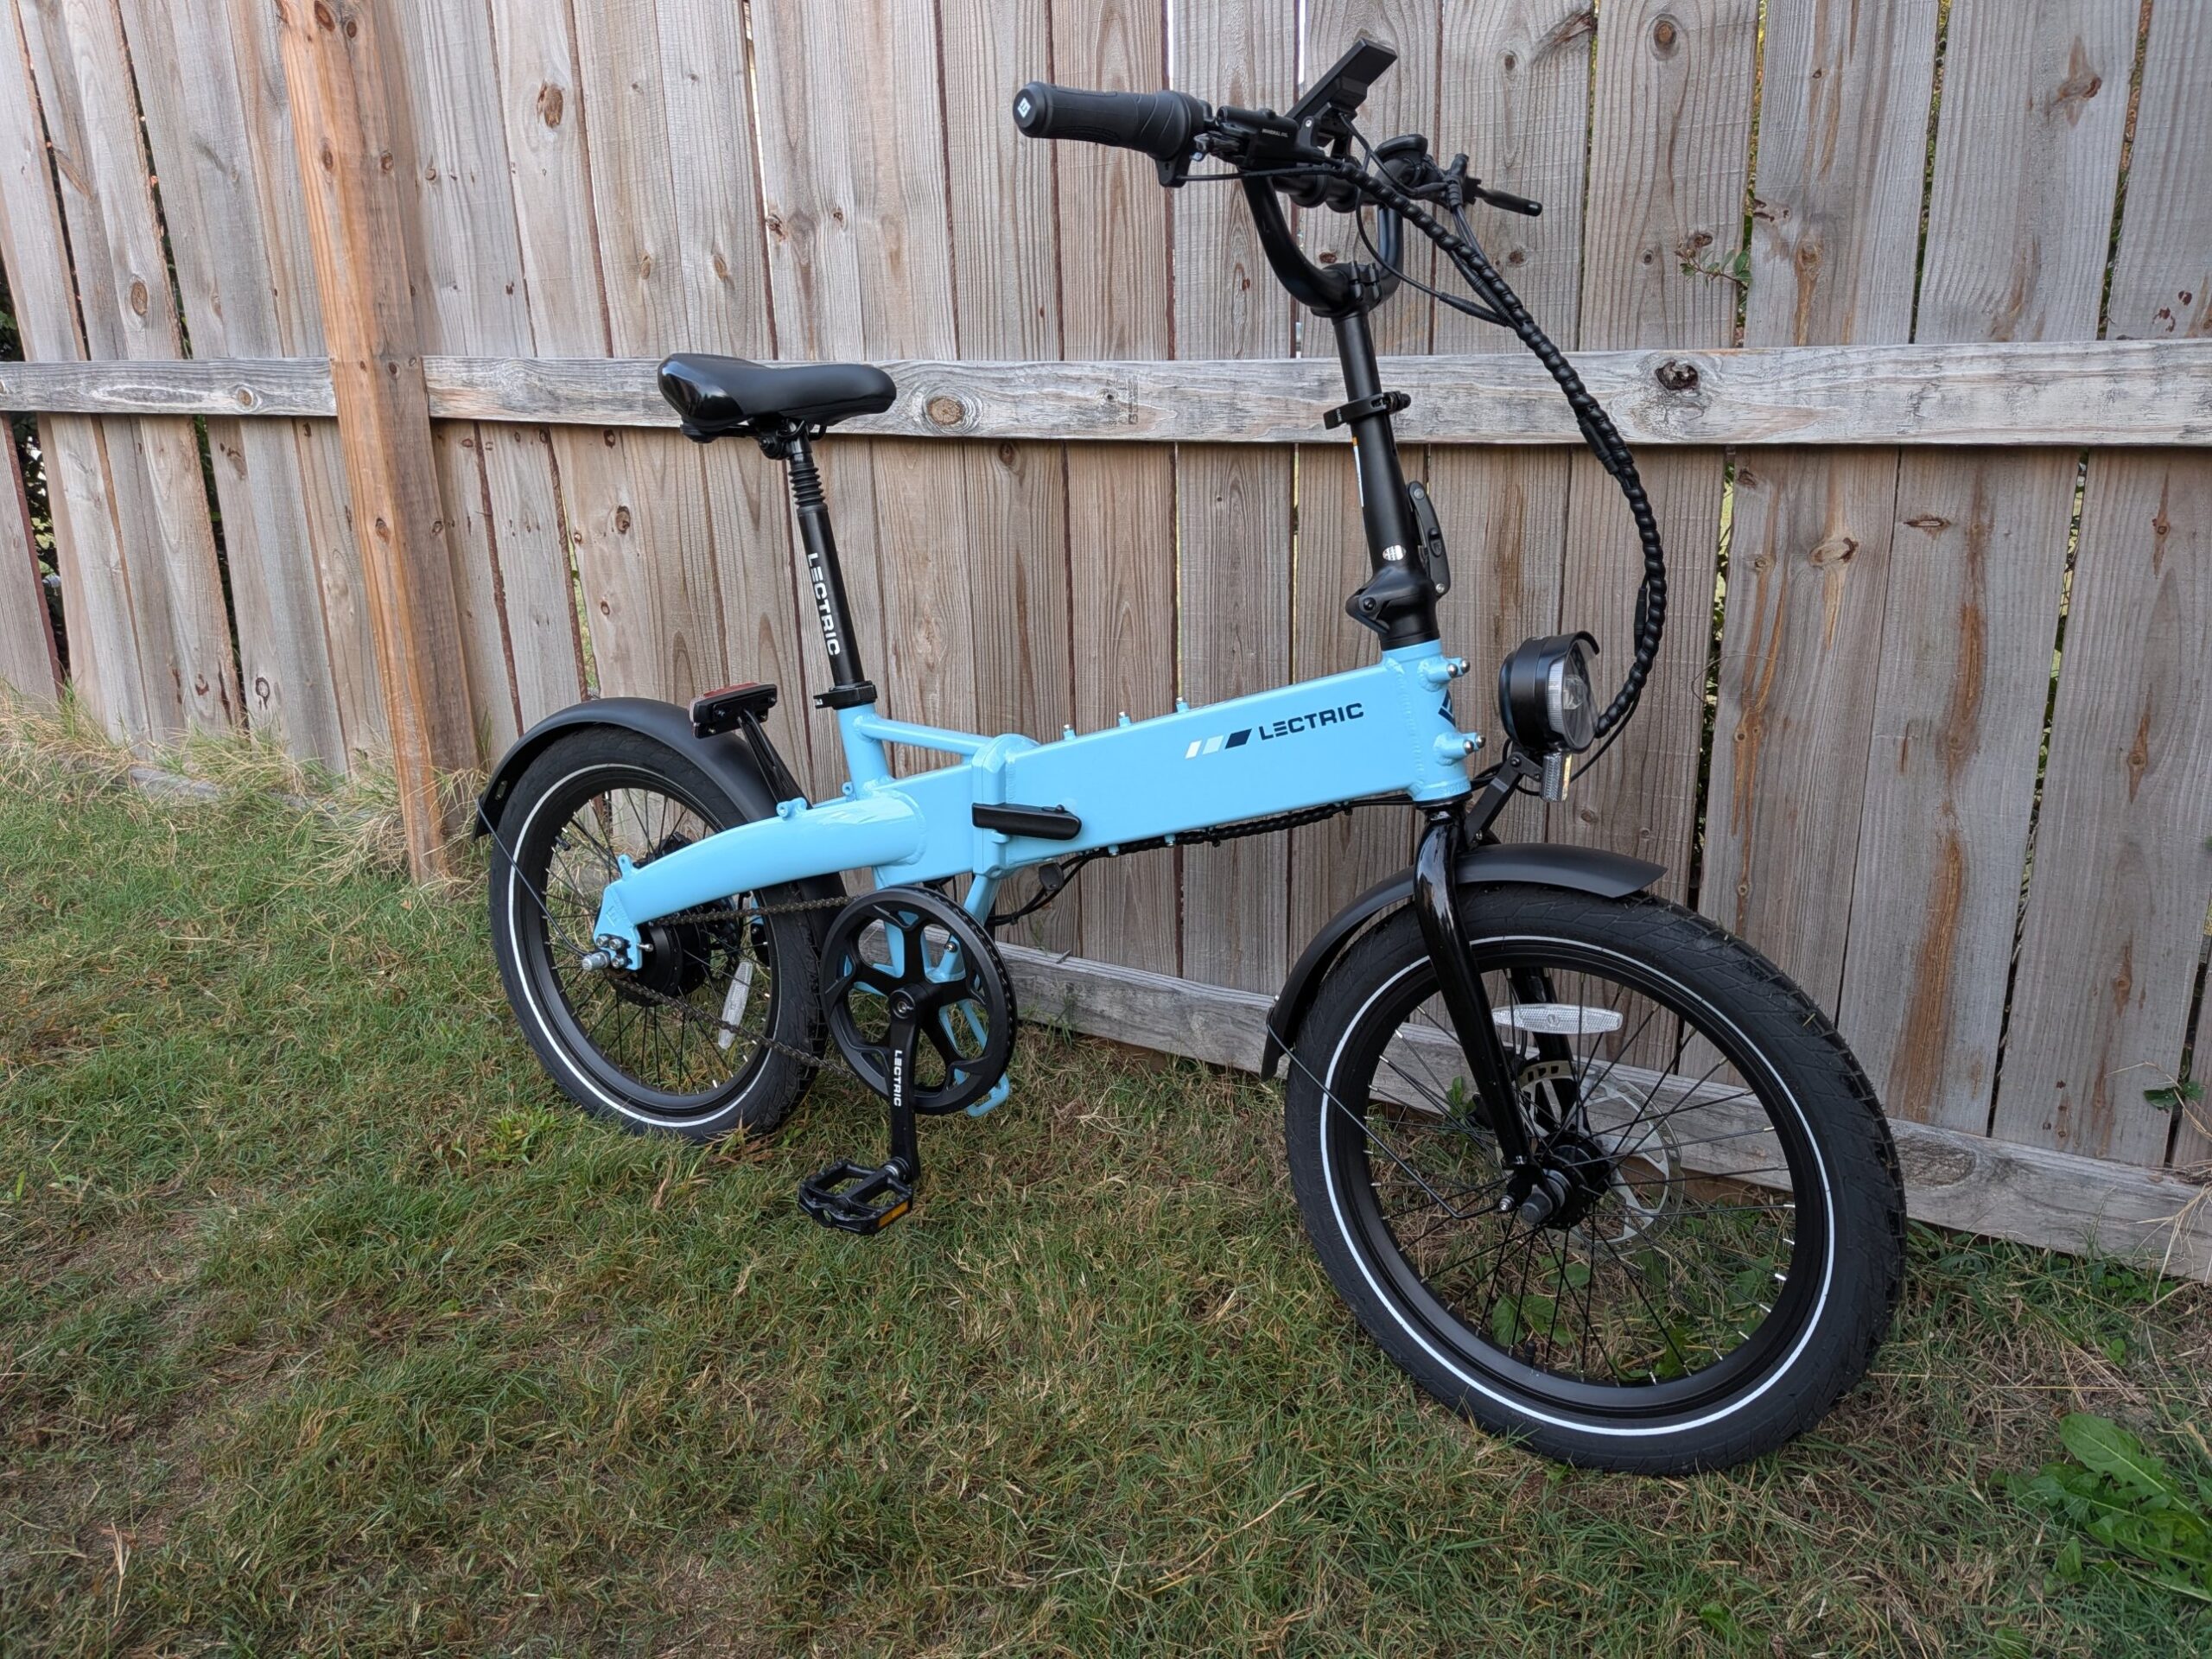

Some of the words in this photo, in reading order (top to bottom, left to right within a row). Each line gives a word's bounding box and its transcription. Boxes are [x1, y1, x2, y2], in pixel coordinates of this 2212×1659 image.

[807, 552, 841, 656] LECTRIC
[1259, 702, 1364, 741] LECTRIC
[893, 1050, 903, 1107] LECTRIC
